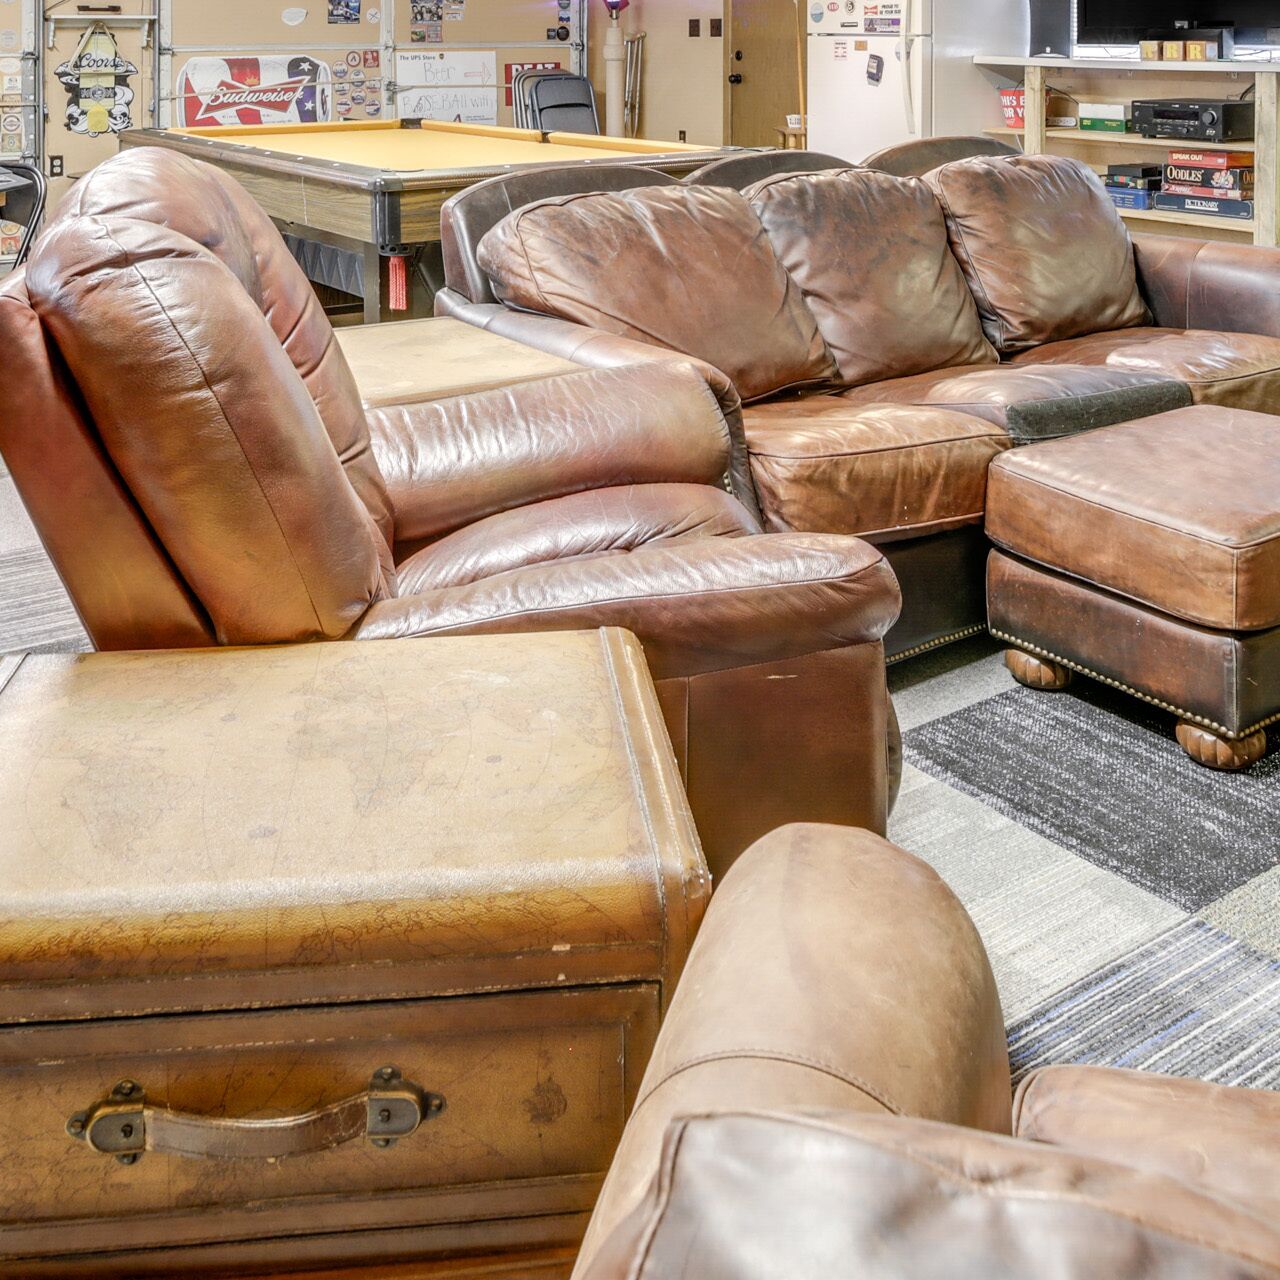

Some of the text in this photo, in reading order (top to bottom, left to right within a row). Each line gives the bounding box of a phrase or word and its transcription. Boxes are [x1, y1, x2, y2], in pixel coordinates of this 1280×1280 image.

[1169, 43, 1177, 57] R
[1189, 44, 1201, 58] R
[79, 53, 123, 68] Coors
[207, 85, 304, 106] Budweiser
[1001, 95, 1017, 105] HIS
[1172, 152, 1188, 160] SPEAK
[1167, 166, 1203, 181] OODLES
